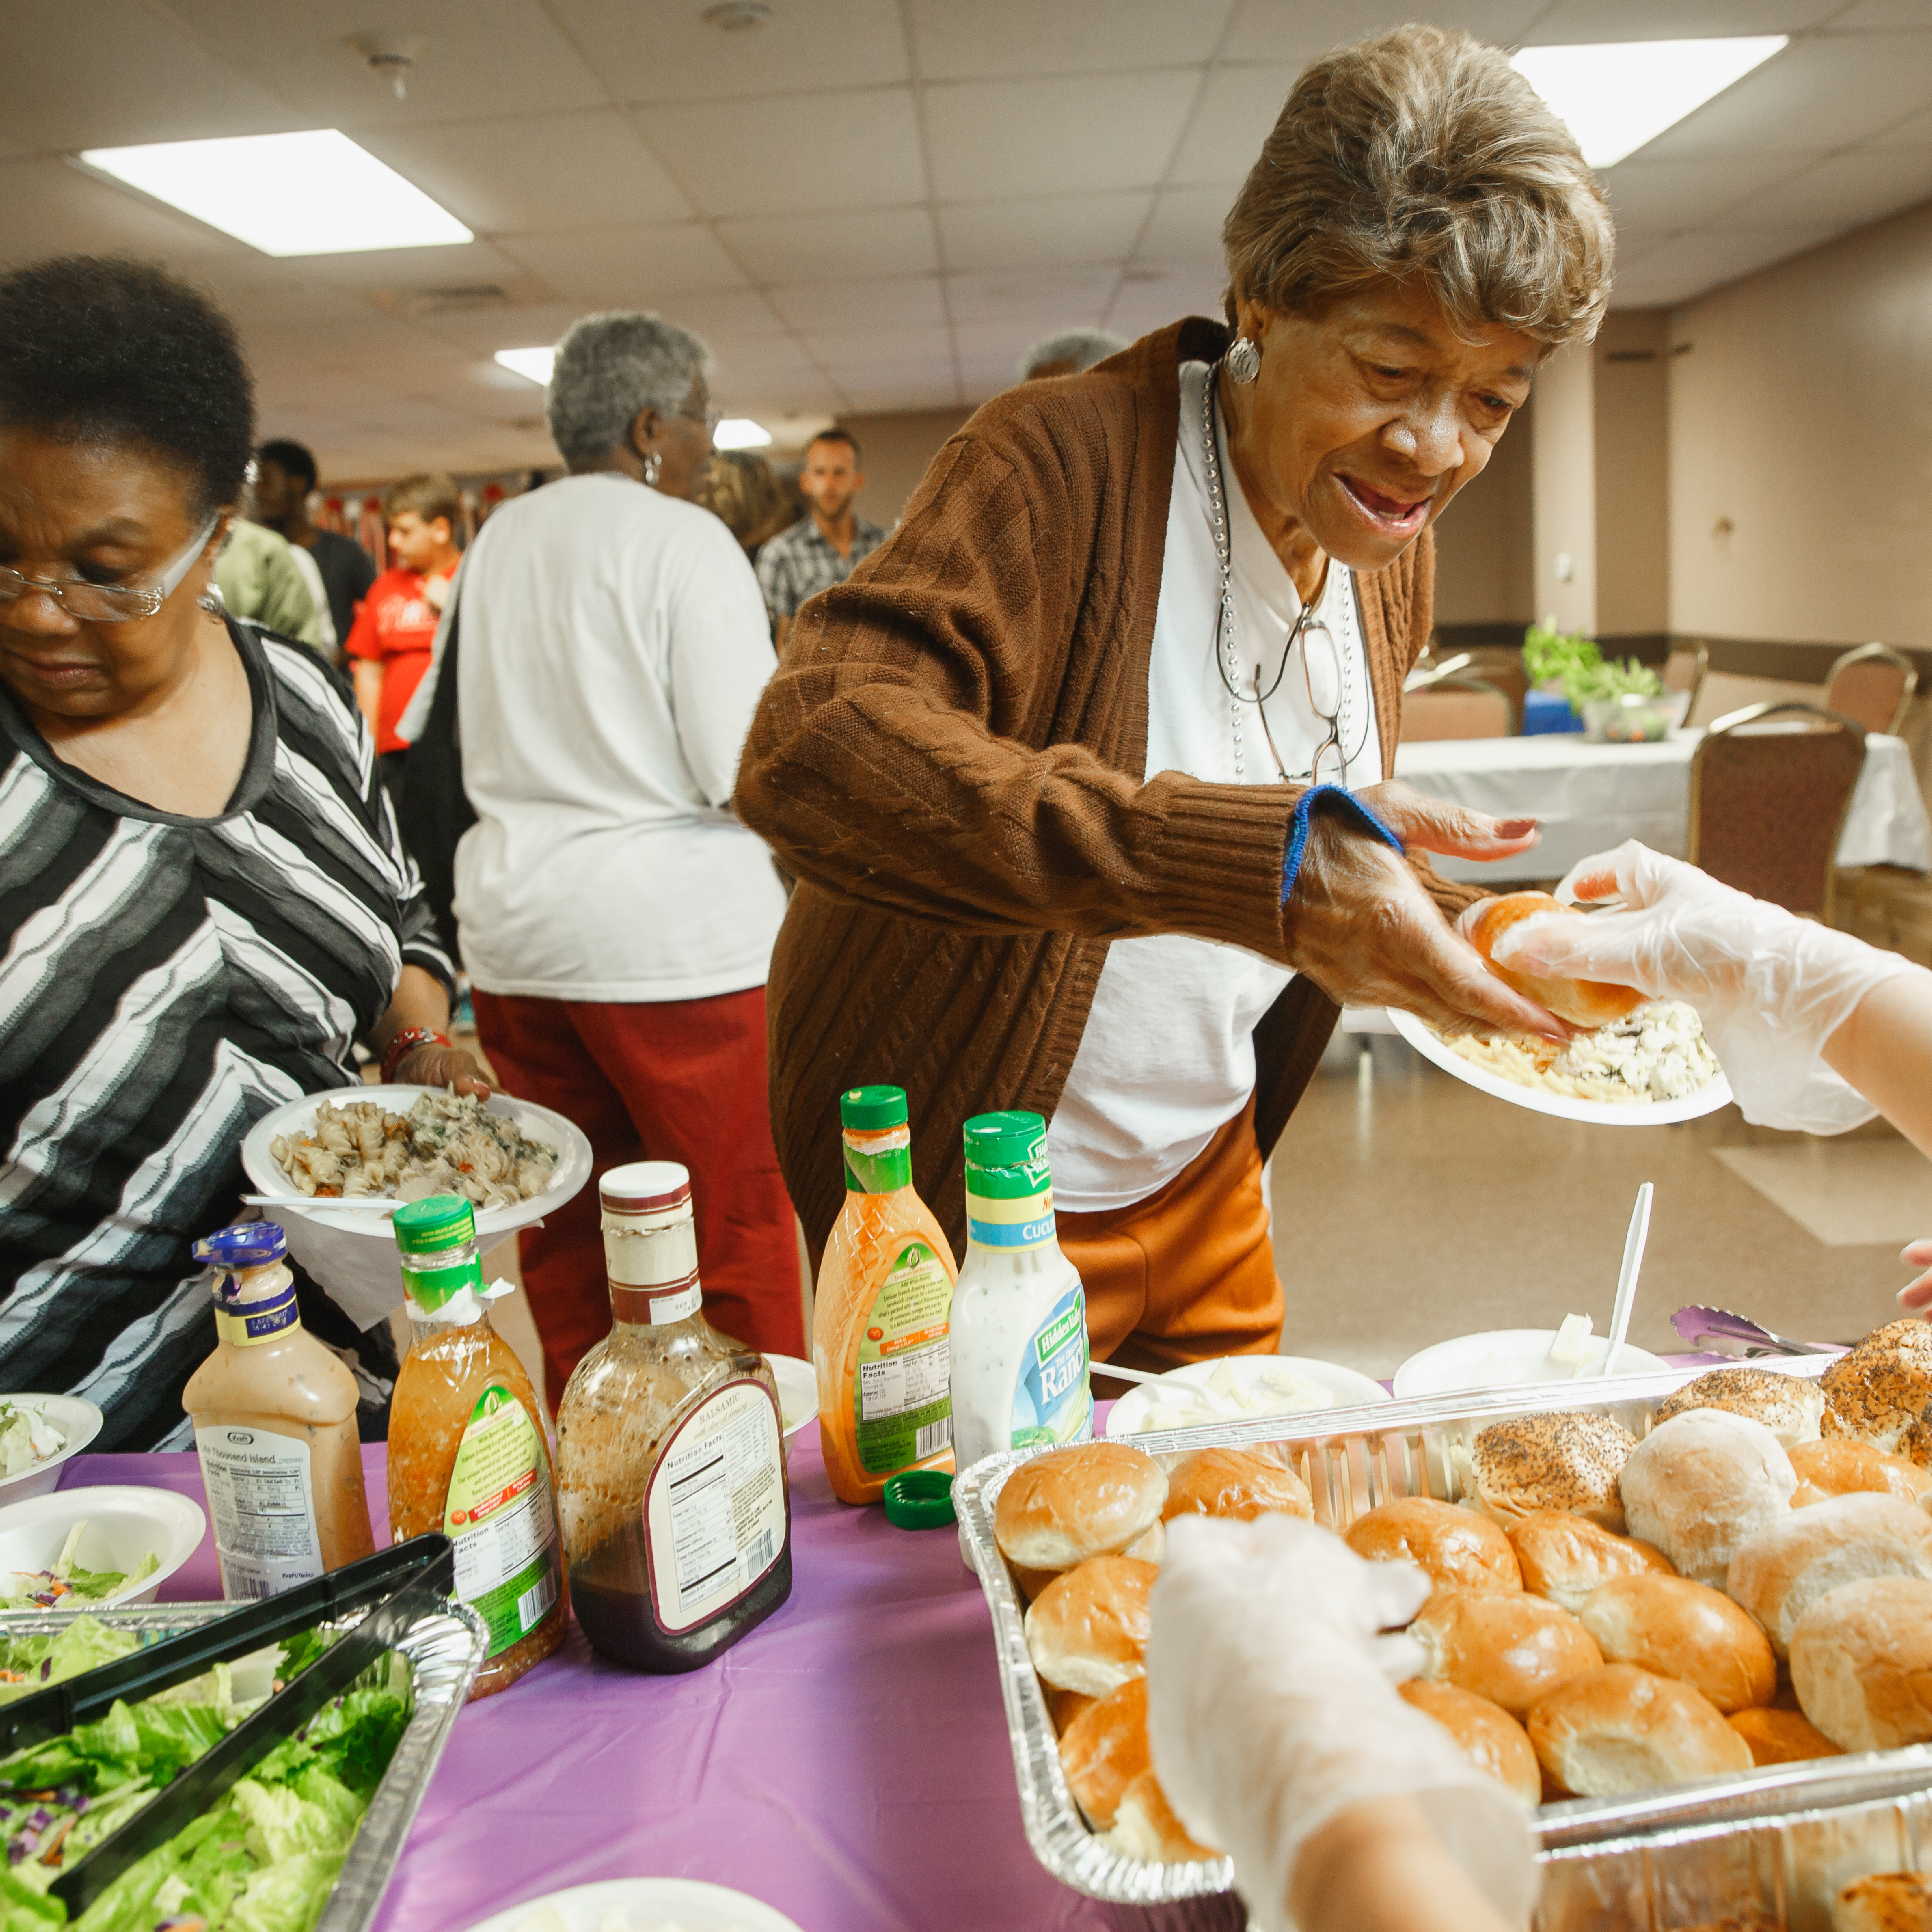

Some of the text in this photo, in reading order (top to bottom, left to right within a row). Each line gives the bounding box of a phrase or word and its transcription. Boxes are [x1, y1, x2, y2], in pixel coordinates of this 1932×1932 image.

[1041, 1321, 1070, 1355] Hidden
[863, 1360, 897, 1371] Nutrition
[699, 1392, 740, 1425] BALSAMIC
[249, 1454, 275, 1464] Island
[667, 1434, 722, 1471] Nutrition Facts
[453, 1527, 489, 1546] Nutrition
